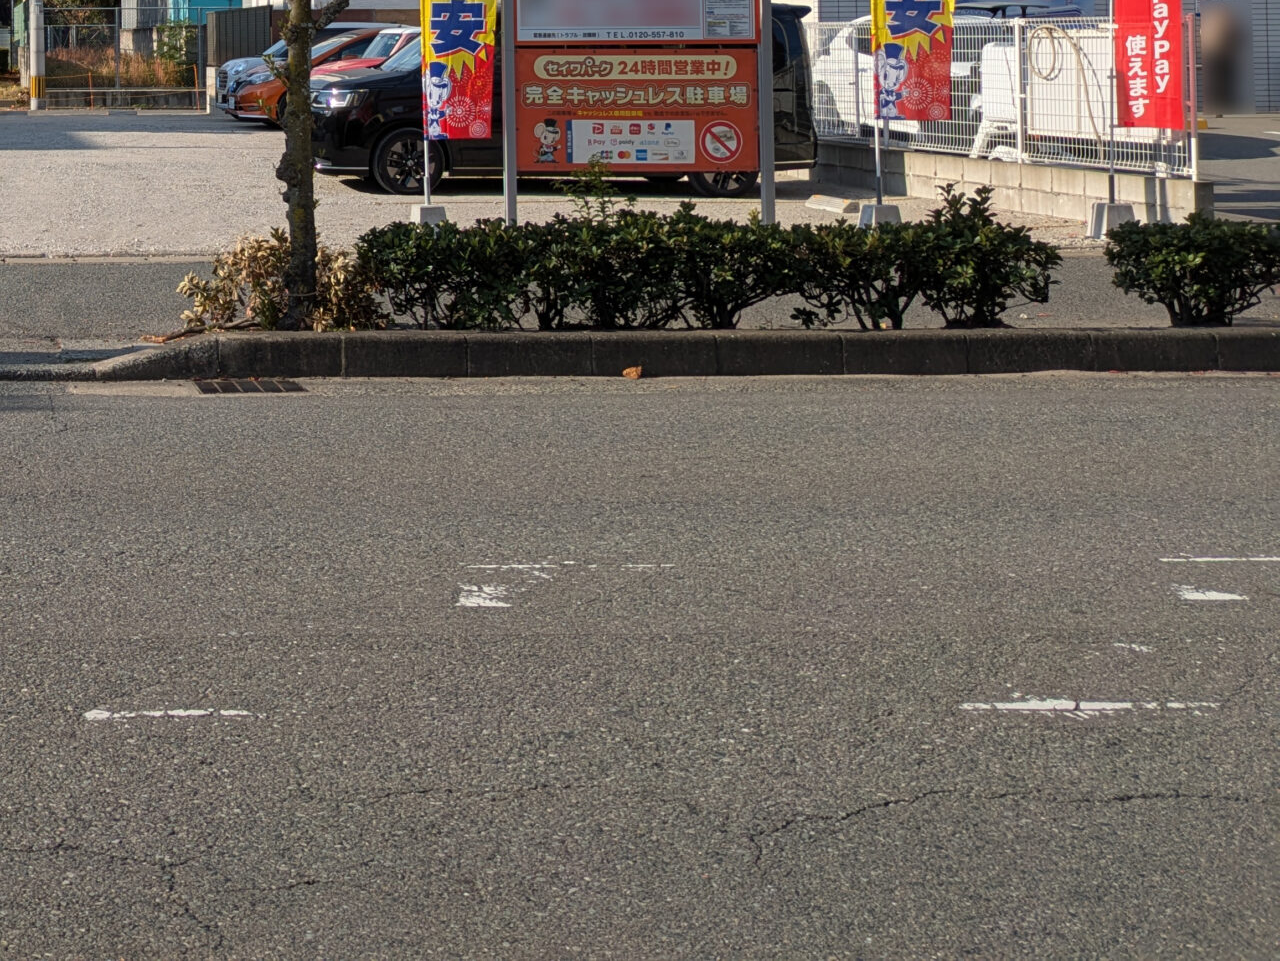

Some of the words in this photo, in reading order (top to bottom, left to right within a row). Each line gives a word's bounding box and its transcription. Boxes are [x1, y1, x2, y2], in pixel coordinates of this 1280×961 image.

[545, 57, 612, 77] セイワパーク
[617, 59, 730, 76] 24時間営業中!
[1125, 35, 1150, 118] 使えます
[525, 86, 748, 105] 完全キャッシュレス駐車場
